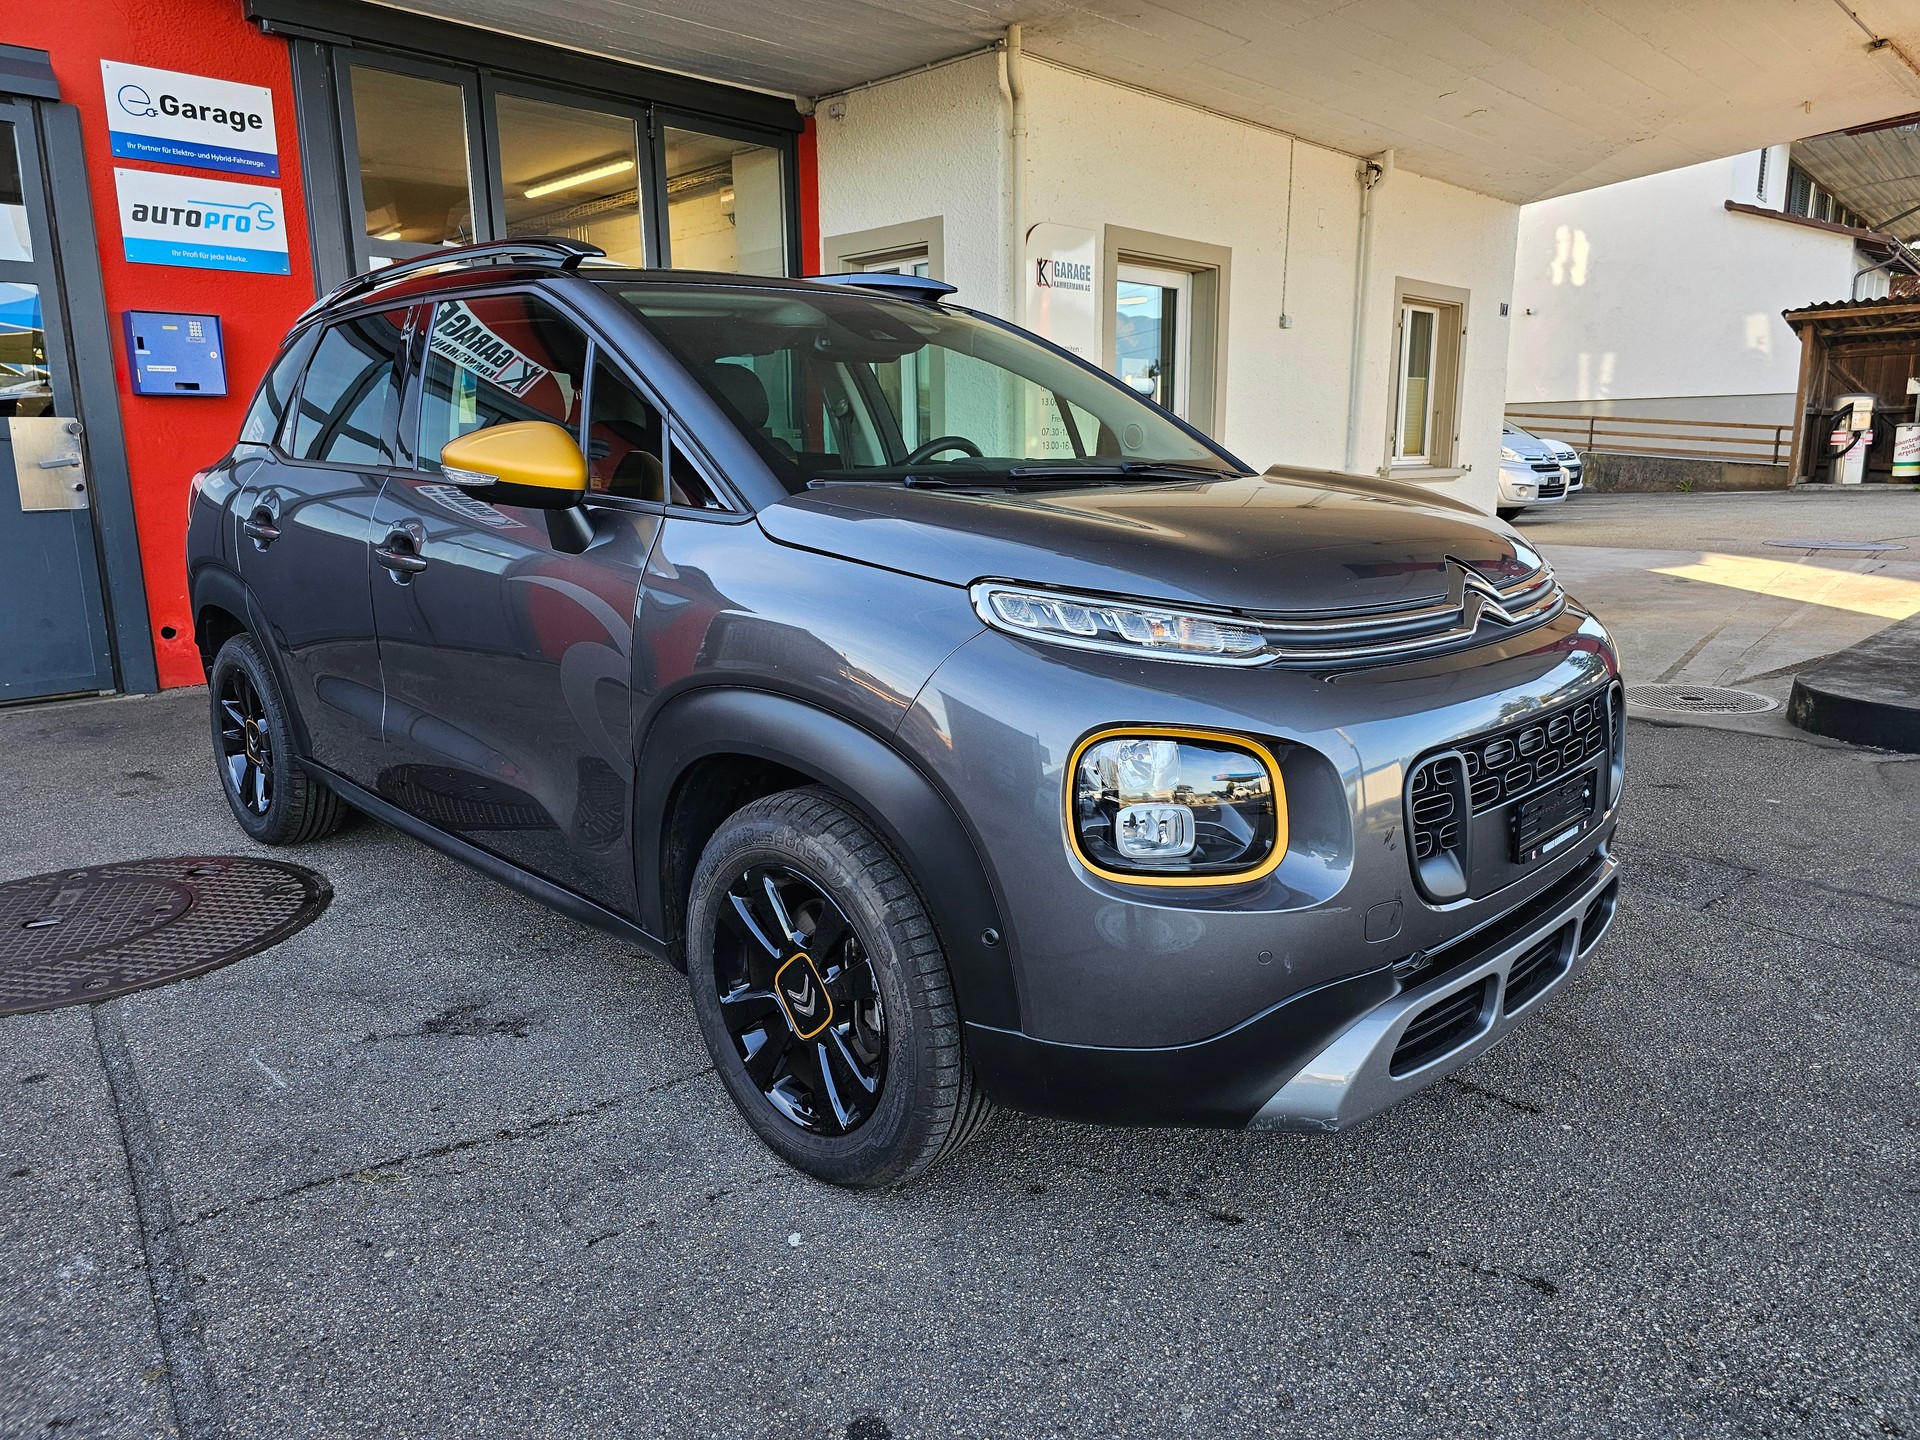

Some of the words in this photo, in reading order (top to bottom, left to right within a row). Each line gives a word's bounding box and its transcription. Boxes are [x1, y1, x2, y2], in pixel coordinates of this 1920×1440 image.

[127, 141, 136, 149] Ihr
[137, 143, 161, 152] Partner
[162, 146, 171, 154] für
[172, 148, 197, 158] Elektro-
[198, 152, 210, 160] und
[211, 153, 266, 168] Hybrid-Fahrzeuge.
[182, 250, 199, 258] Profi
[199, 251, 209, 259] für
[210, 253, 225, 261] jede
[226, 254, 249, 263] Marke.
[1053, 260, 1091, 282] GARAGE
[1053, 280, 1084, 291] KAMMERMANN
[1085, 284, 1091, 292] AG
